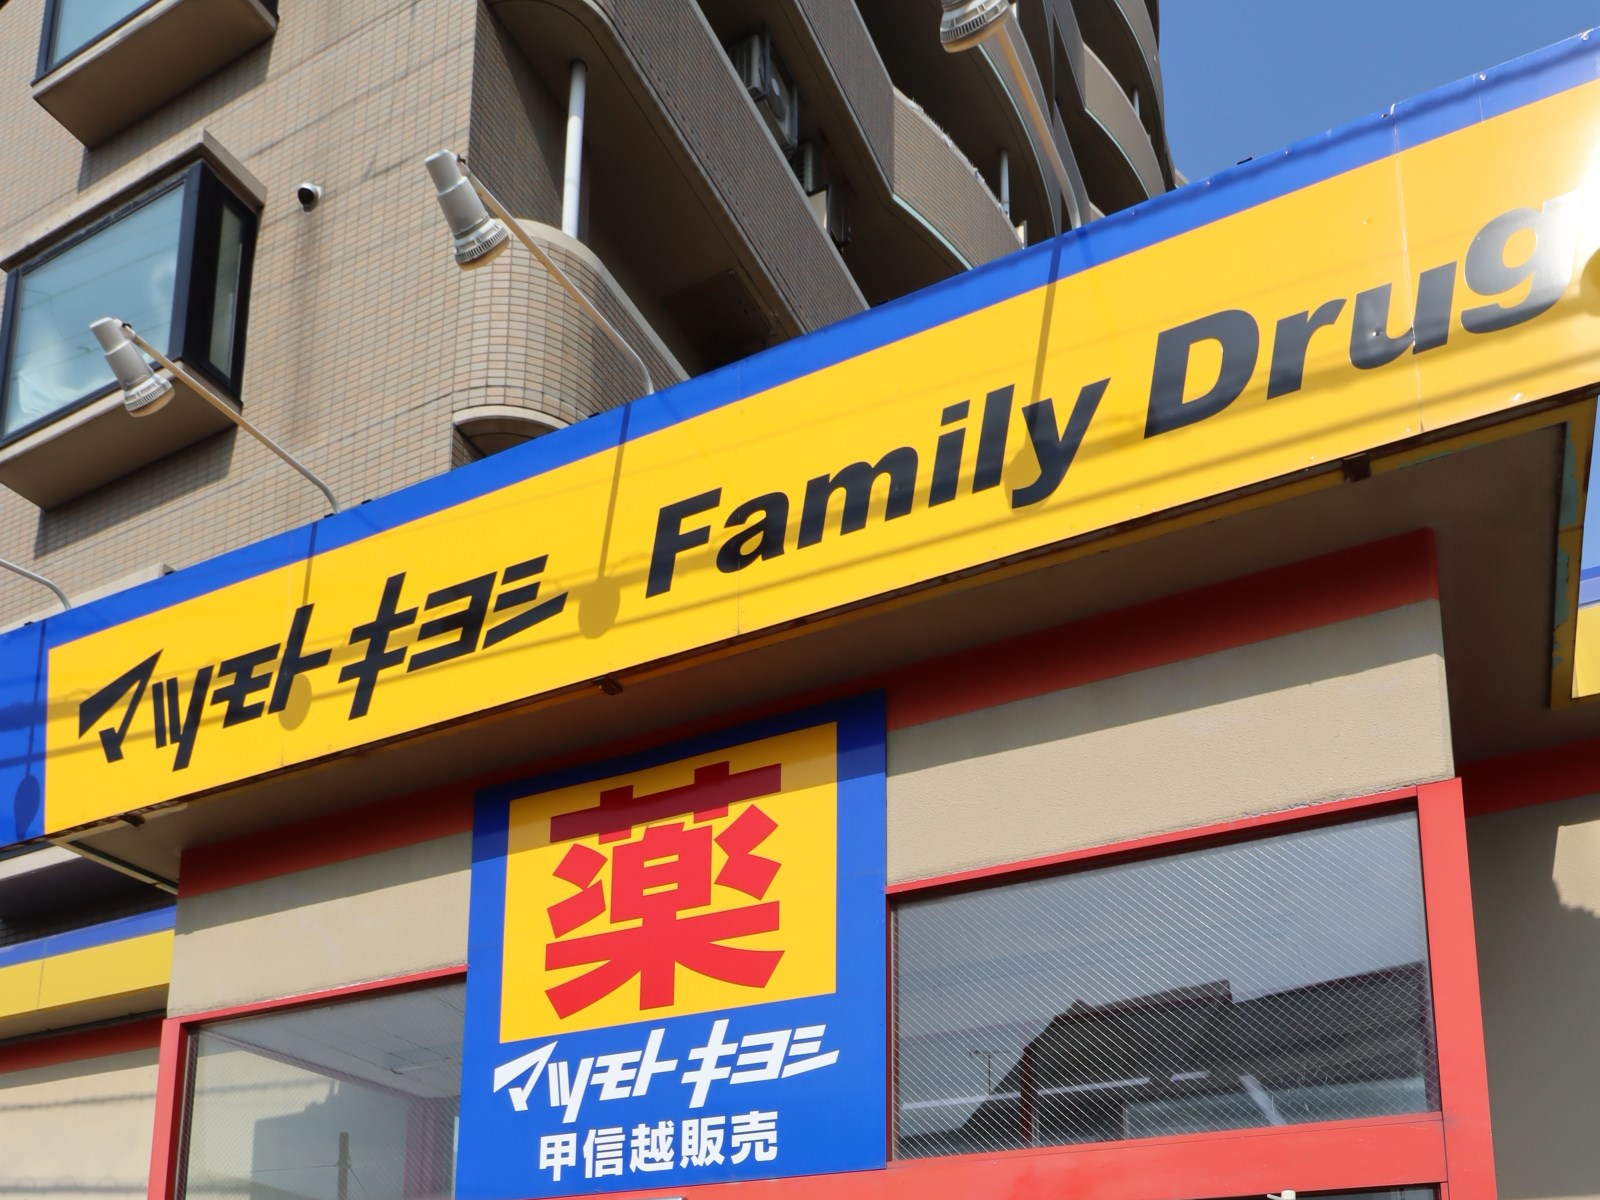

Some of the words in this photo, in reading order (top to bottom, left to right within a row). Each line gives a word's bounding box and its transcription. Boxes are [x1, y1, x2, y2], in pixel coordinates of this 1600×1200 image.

[646, 377, 1111, 597] Family
[1144, 190, 1580, 438] Drug
[545, 761, 784, 1019] 薬
[493, 1019, 839, 1124] マツモトキヨシ
[539, 1111, 778, 1181] 甲信越販売
